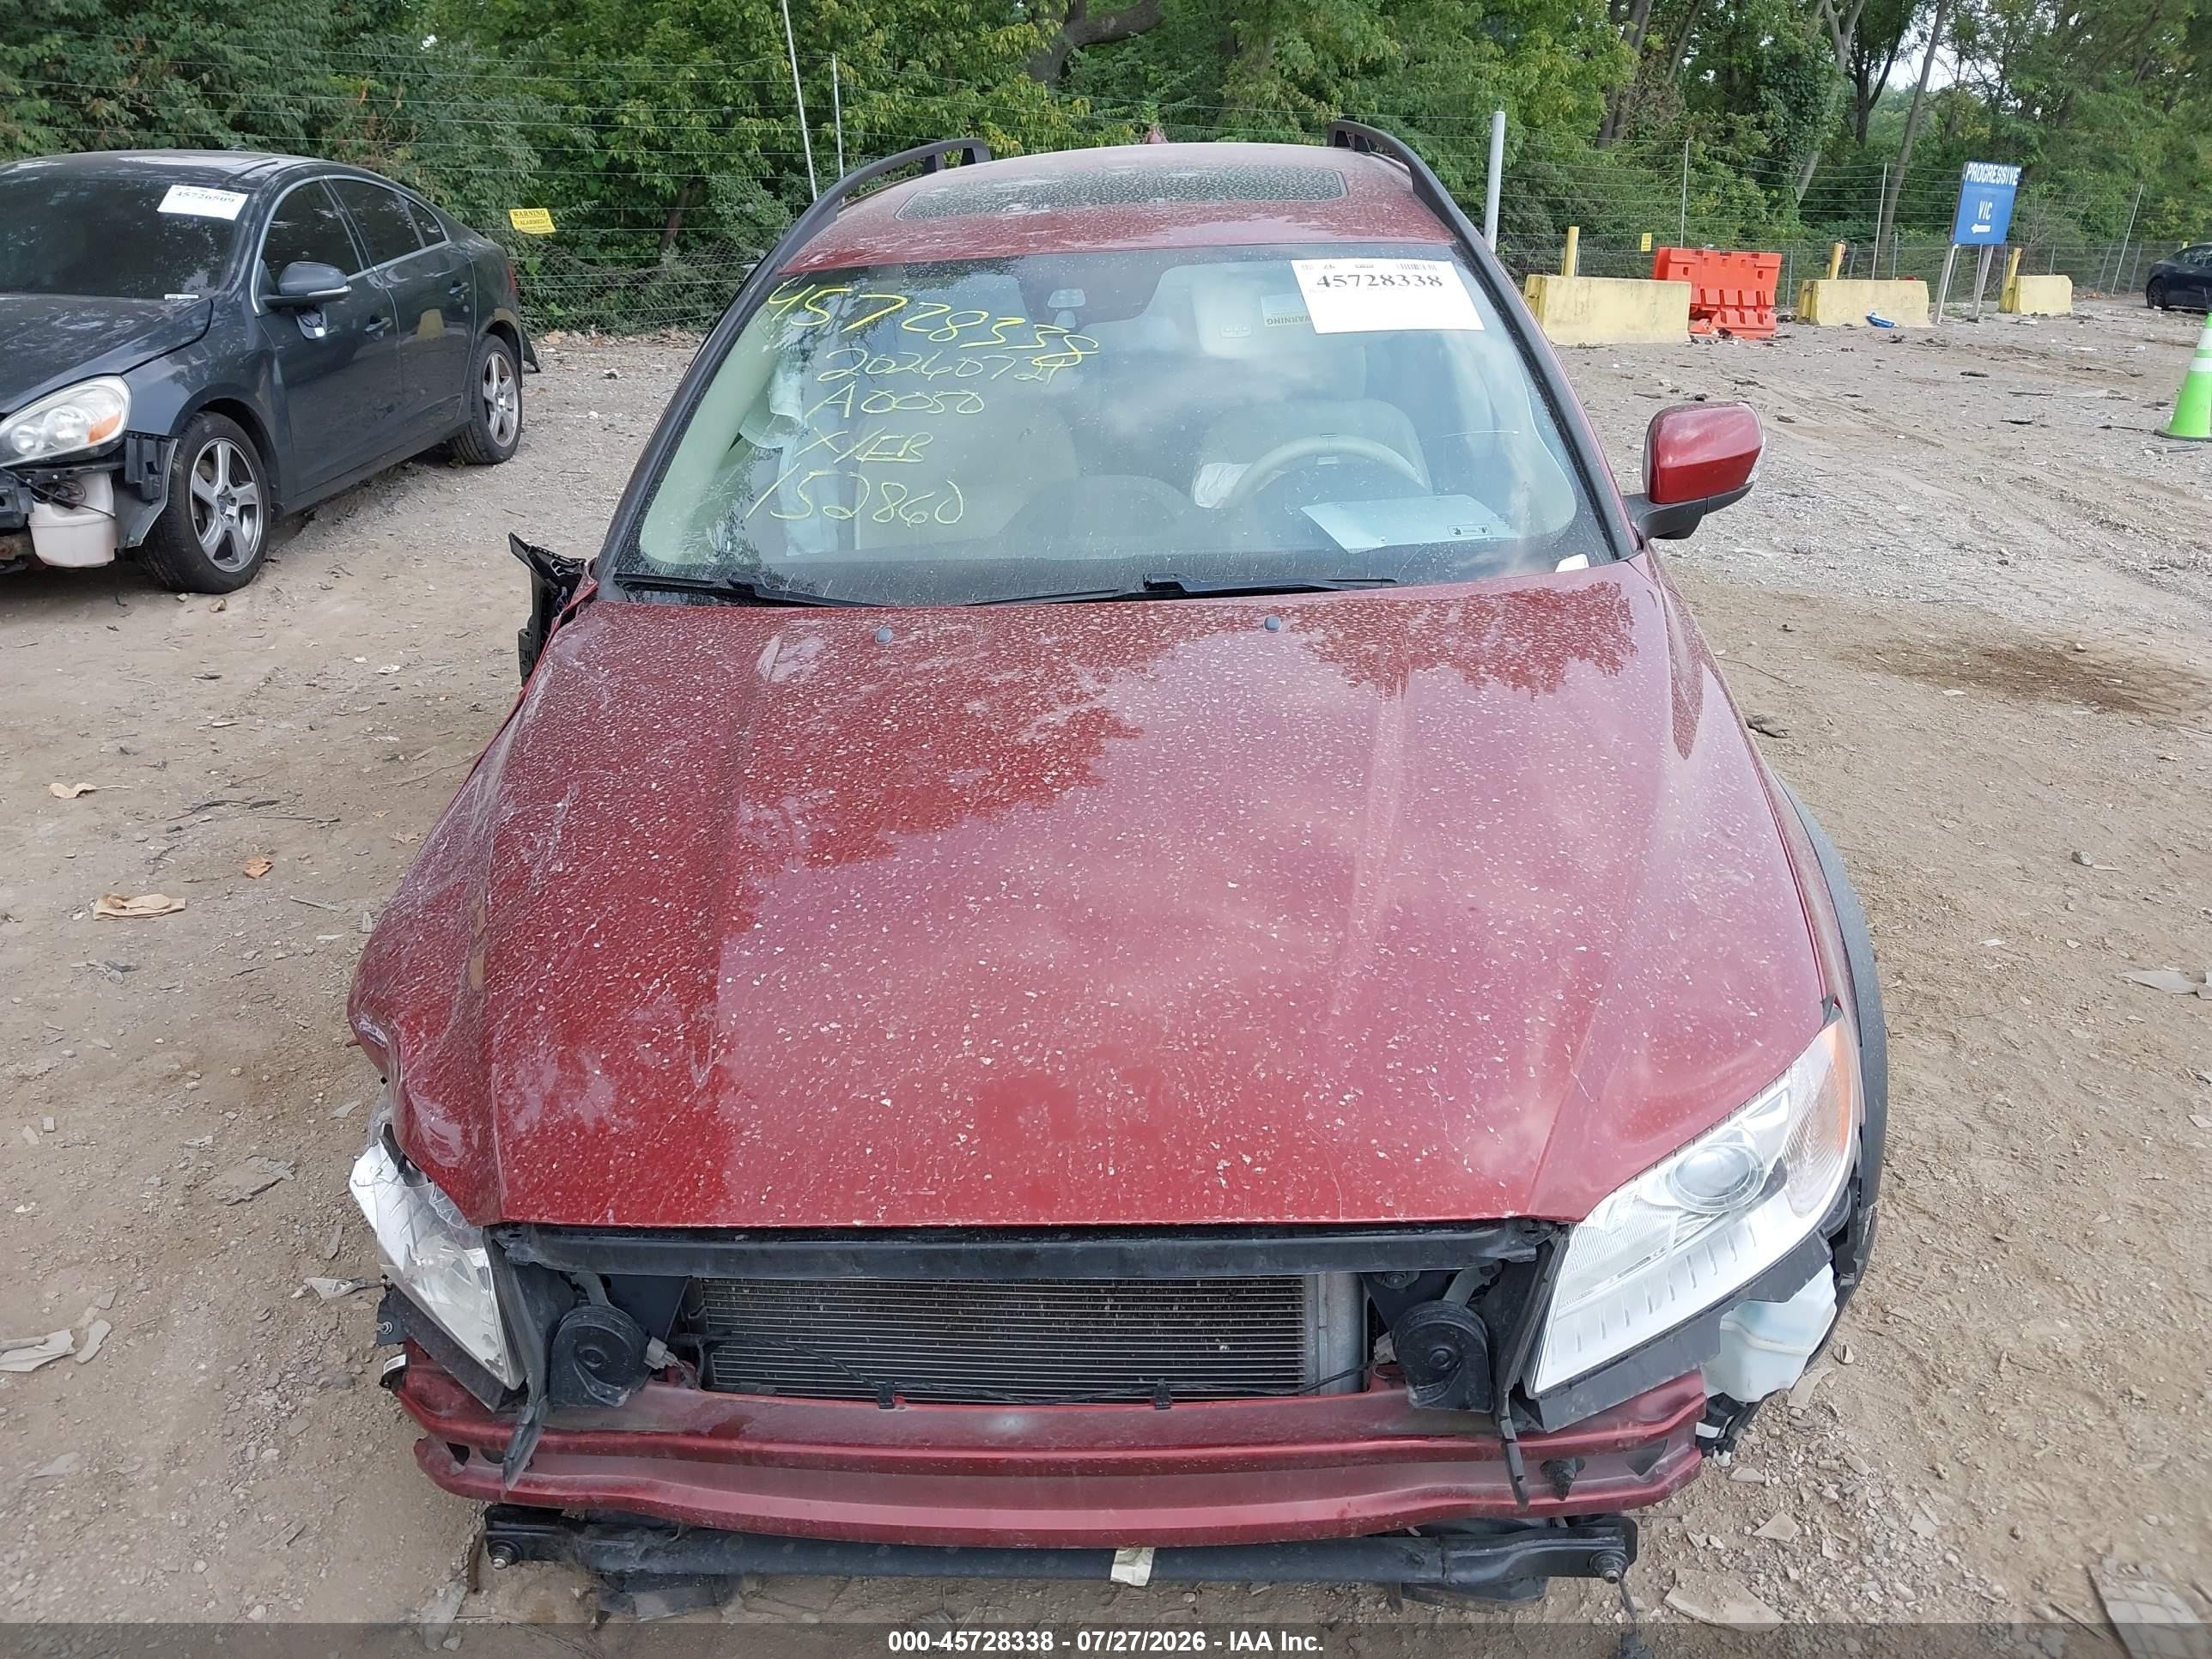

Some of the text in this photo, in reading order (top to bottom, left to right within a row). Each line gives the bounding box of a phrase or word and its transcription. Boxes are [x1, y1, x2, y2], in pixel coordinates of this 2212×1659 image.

[1966, 162, 2022, 186] PROGRESSIVE
[1978, 200, 1993, 221] VIC
[1316, 274, 1443, 288] 45728338
[768, 276, 1100, 368] 45728338
[804, 380, 985, 419] A0050
[746, 463, 963, 529] 152860
